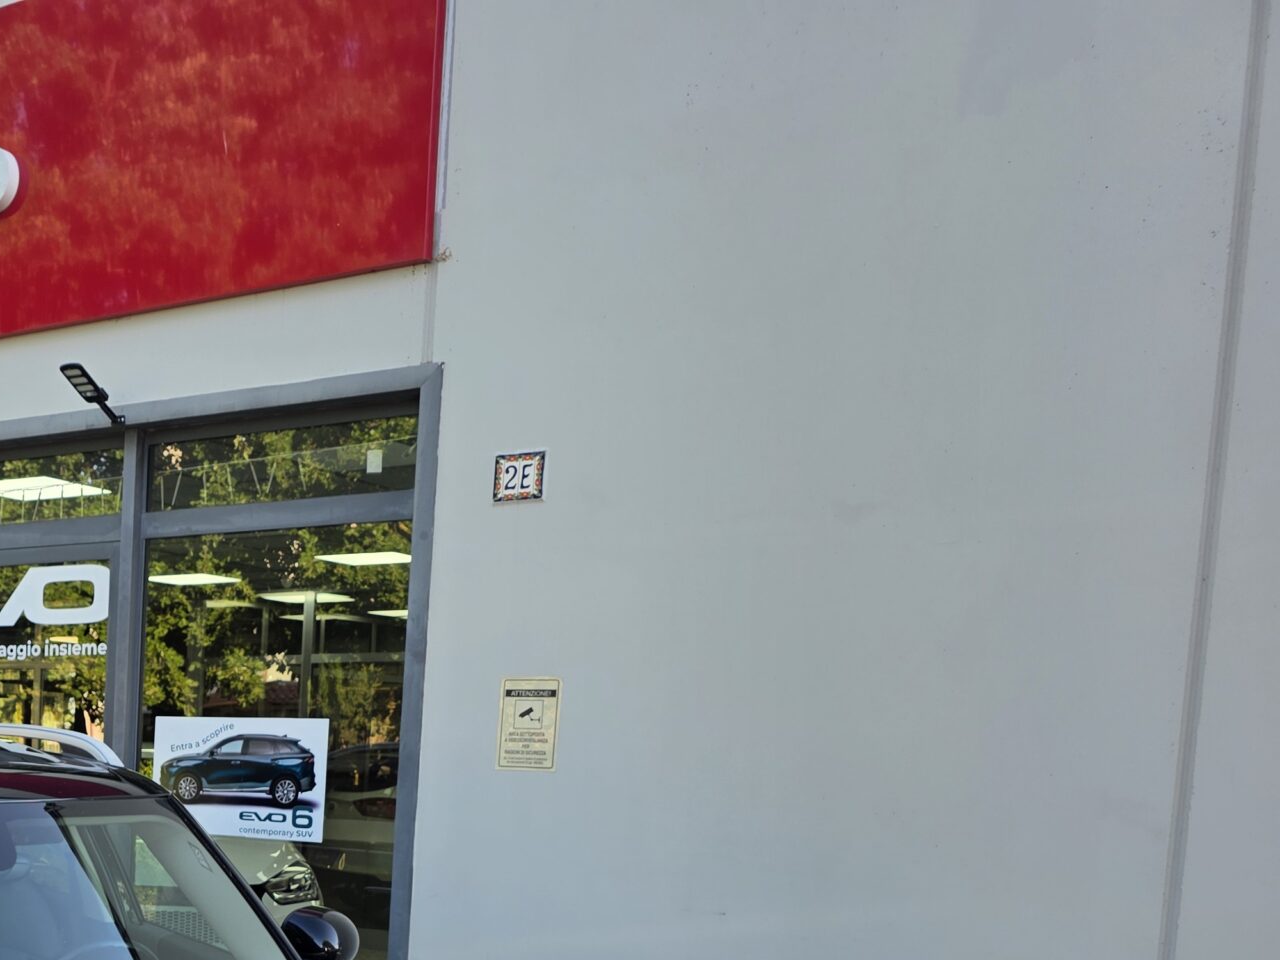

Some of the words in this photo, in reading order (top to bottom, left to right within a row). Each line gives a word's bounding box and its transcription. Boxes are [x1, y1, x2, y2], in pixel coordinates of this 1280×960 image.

[504, 462, 534, 490] 2E
[44, 638, 108, 657] insieme
[170, 742, 193, 752] Entra
[201, 723, 235, 744] scoprire
[239, 811, 287, 823] EVO
[292, 805, 314, 829] 6
[239, 827, 294, 839] contemporary
[295, 830, 314, 838] SUV
